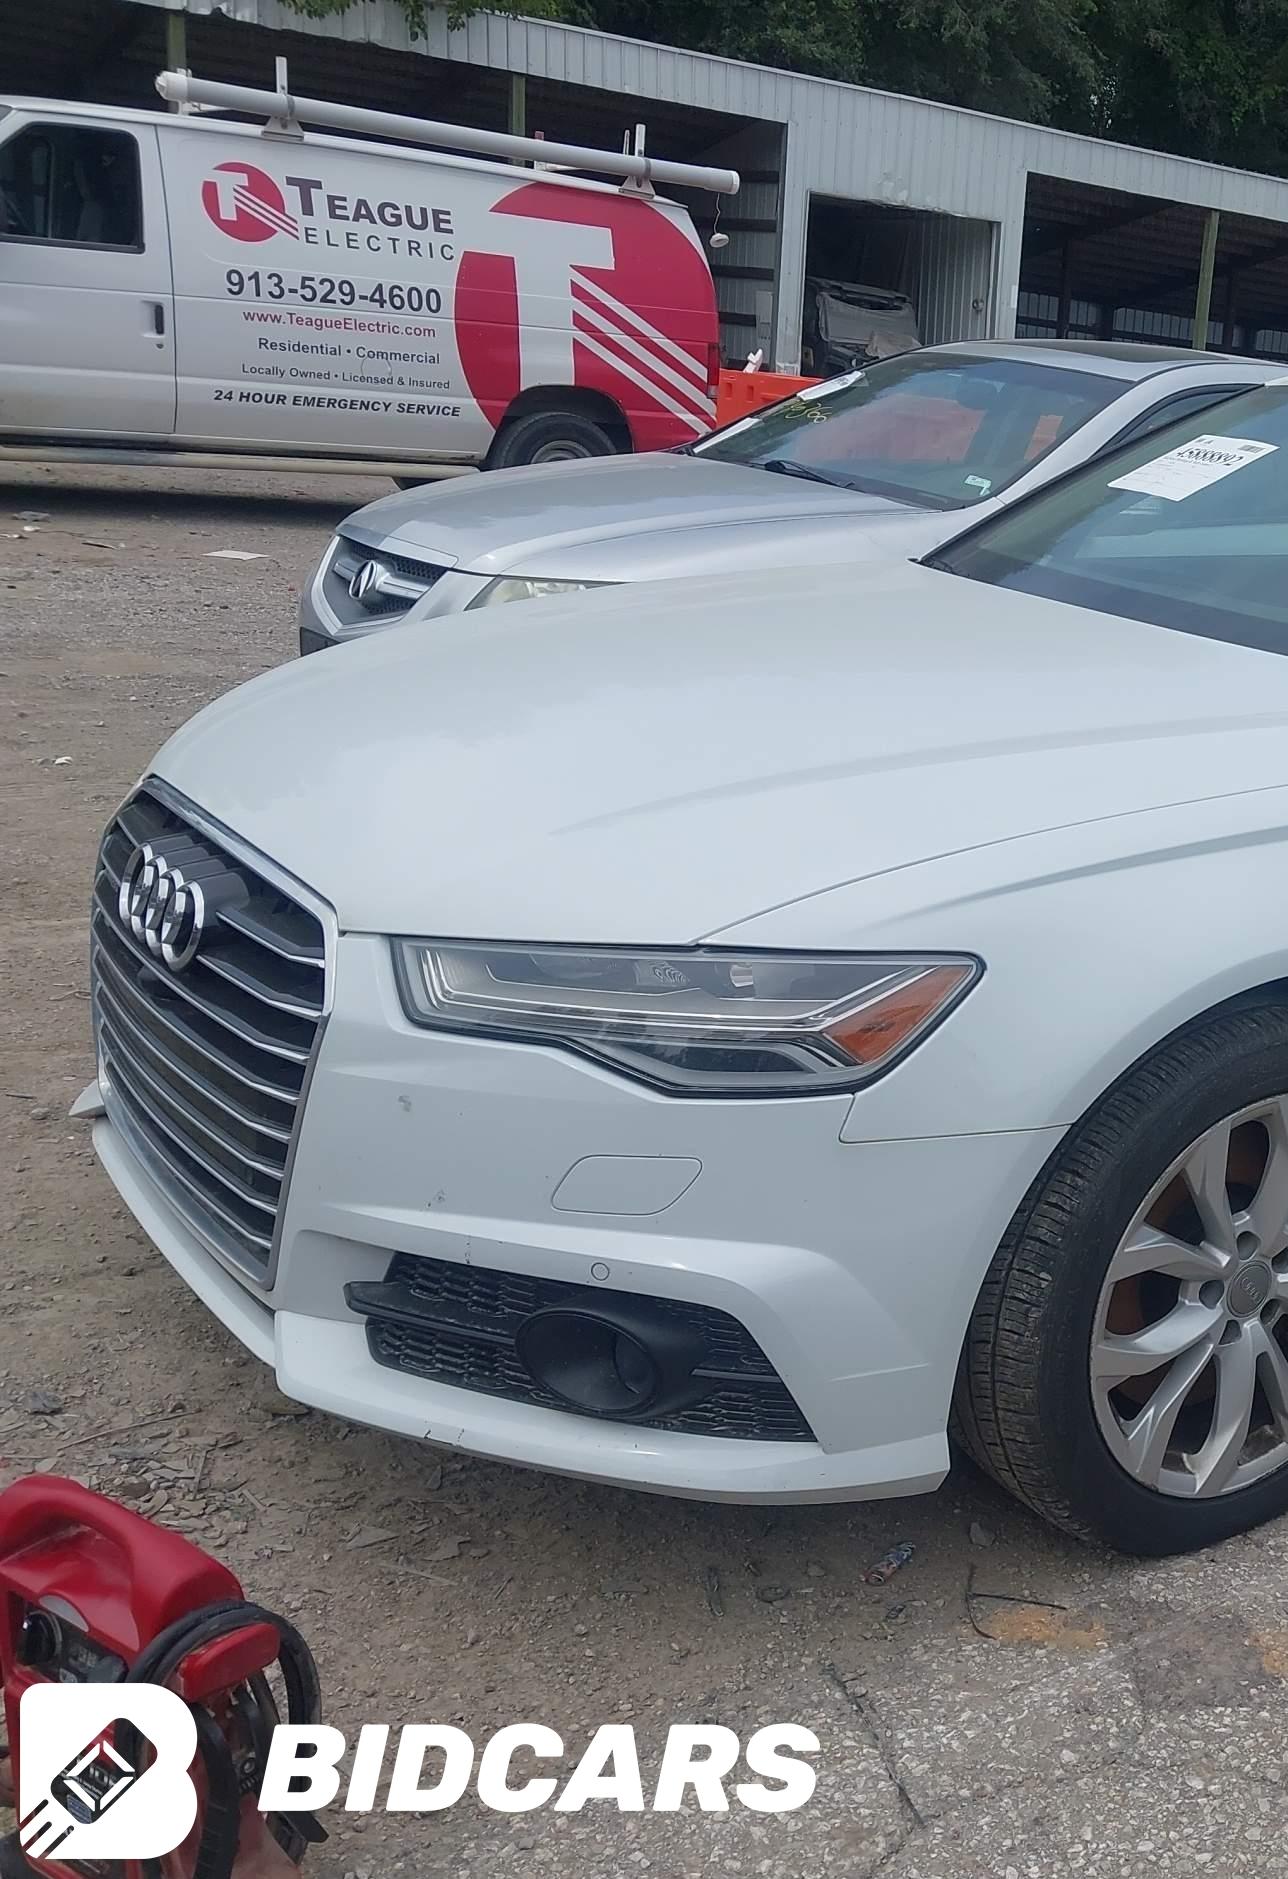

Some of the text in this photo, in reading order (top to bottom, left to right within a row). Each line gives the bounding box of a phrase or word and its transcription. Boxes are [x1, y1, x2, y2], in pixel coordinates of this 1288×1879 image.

[304, 227, 455, 261] ELECTRIC
[225, 268, 443, 314] 913-529-4600
[243, 310, 437, 338] www.TeagueElectric.com
[258, 337, 440, 365] Residential Commercial
[242, 363, 450, 390] Locally Owned Licensed & Insured
[213, 389, 461, 418] 24 HOUR EMERGENCY SERVICE
